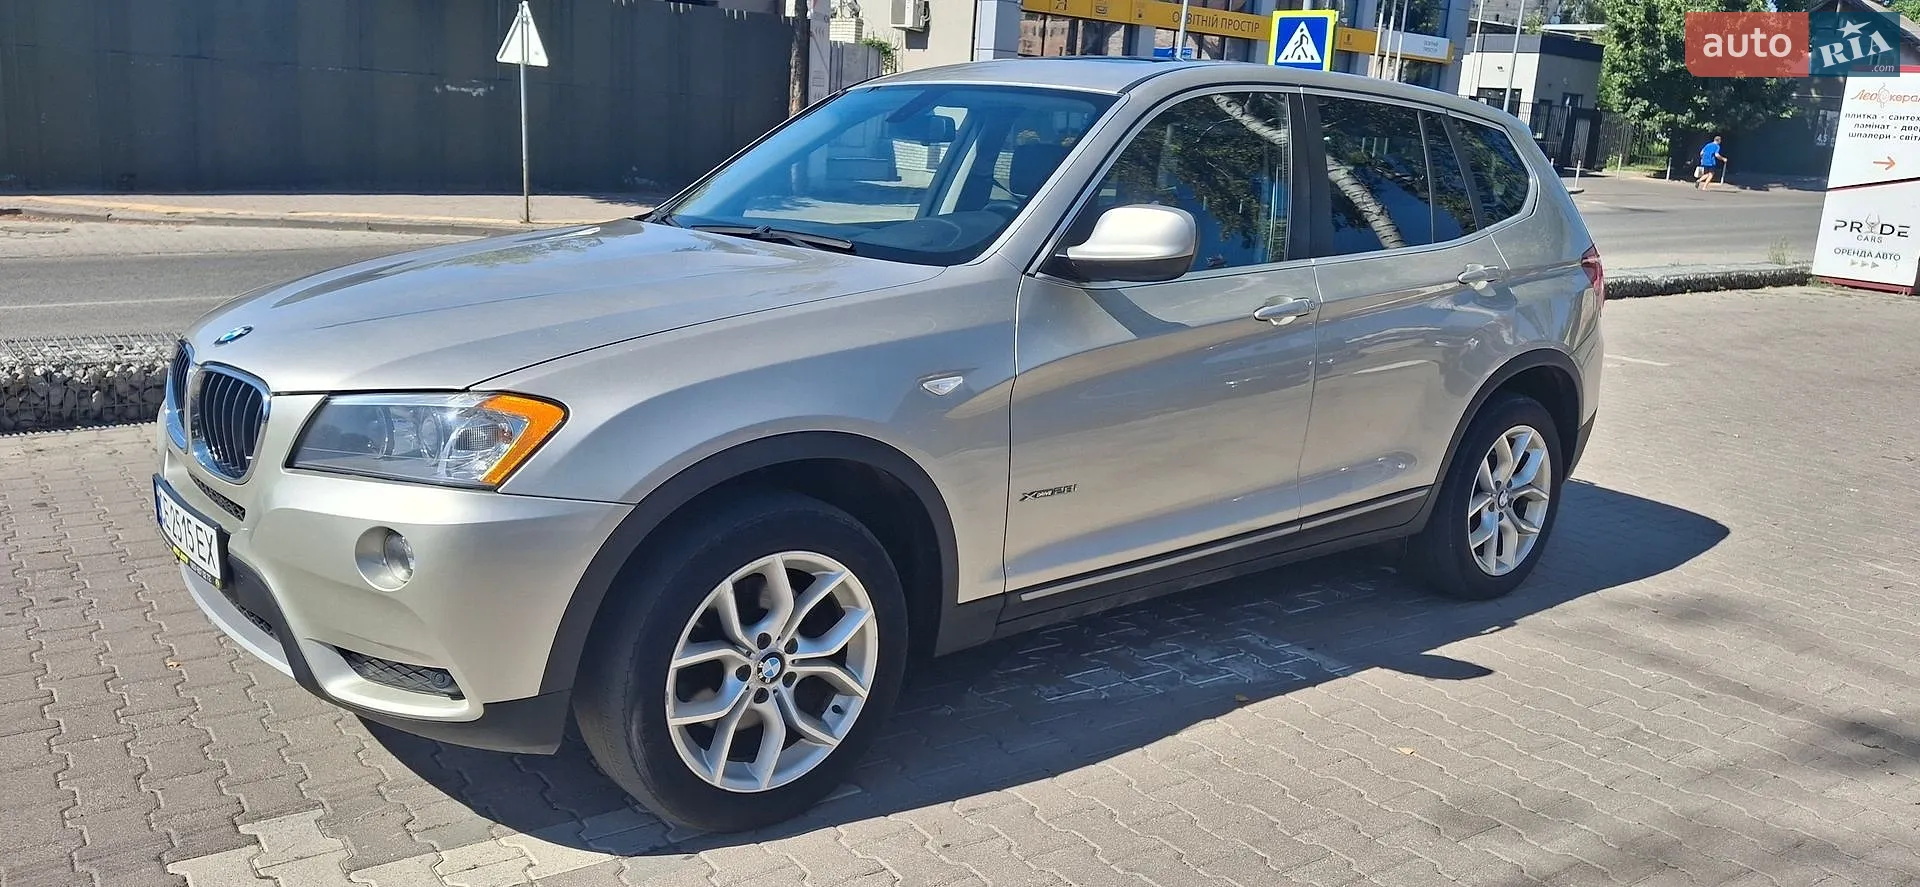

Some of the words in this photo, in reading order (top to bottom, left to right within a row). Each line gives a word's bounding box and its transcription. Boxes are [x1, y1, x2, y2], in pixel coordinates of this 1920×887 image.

[1172, 11, 1218, 28] ОВІТНІЙ
[1220, 17, 1260, 32] ПРОСТІР
[1853, 122, 1891, 130] ламінат
[1848, 132, 1891, 140] шпалери
[1856, 234, 1883, 244] CARS
[1833, 247, 1873, 258] ОРЕНДА
[1875, 251, 1901, 261] АВТО
